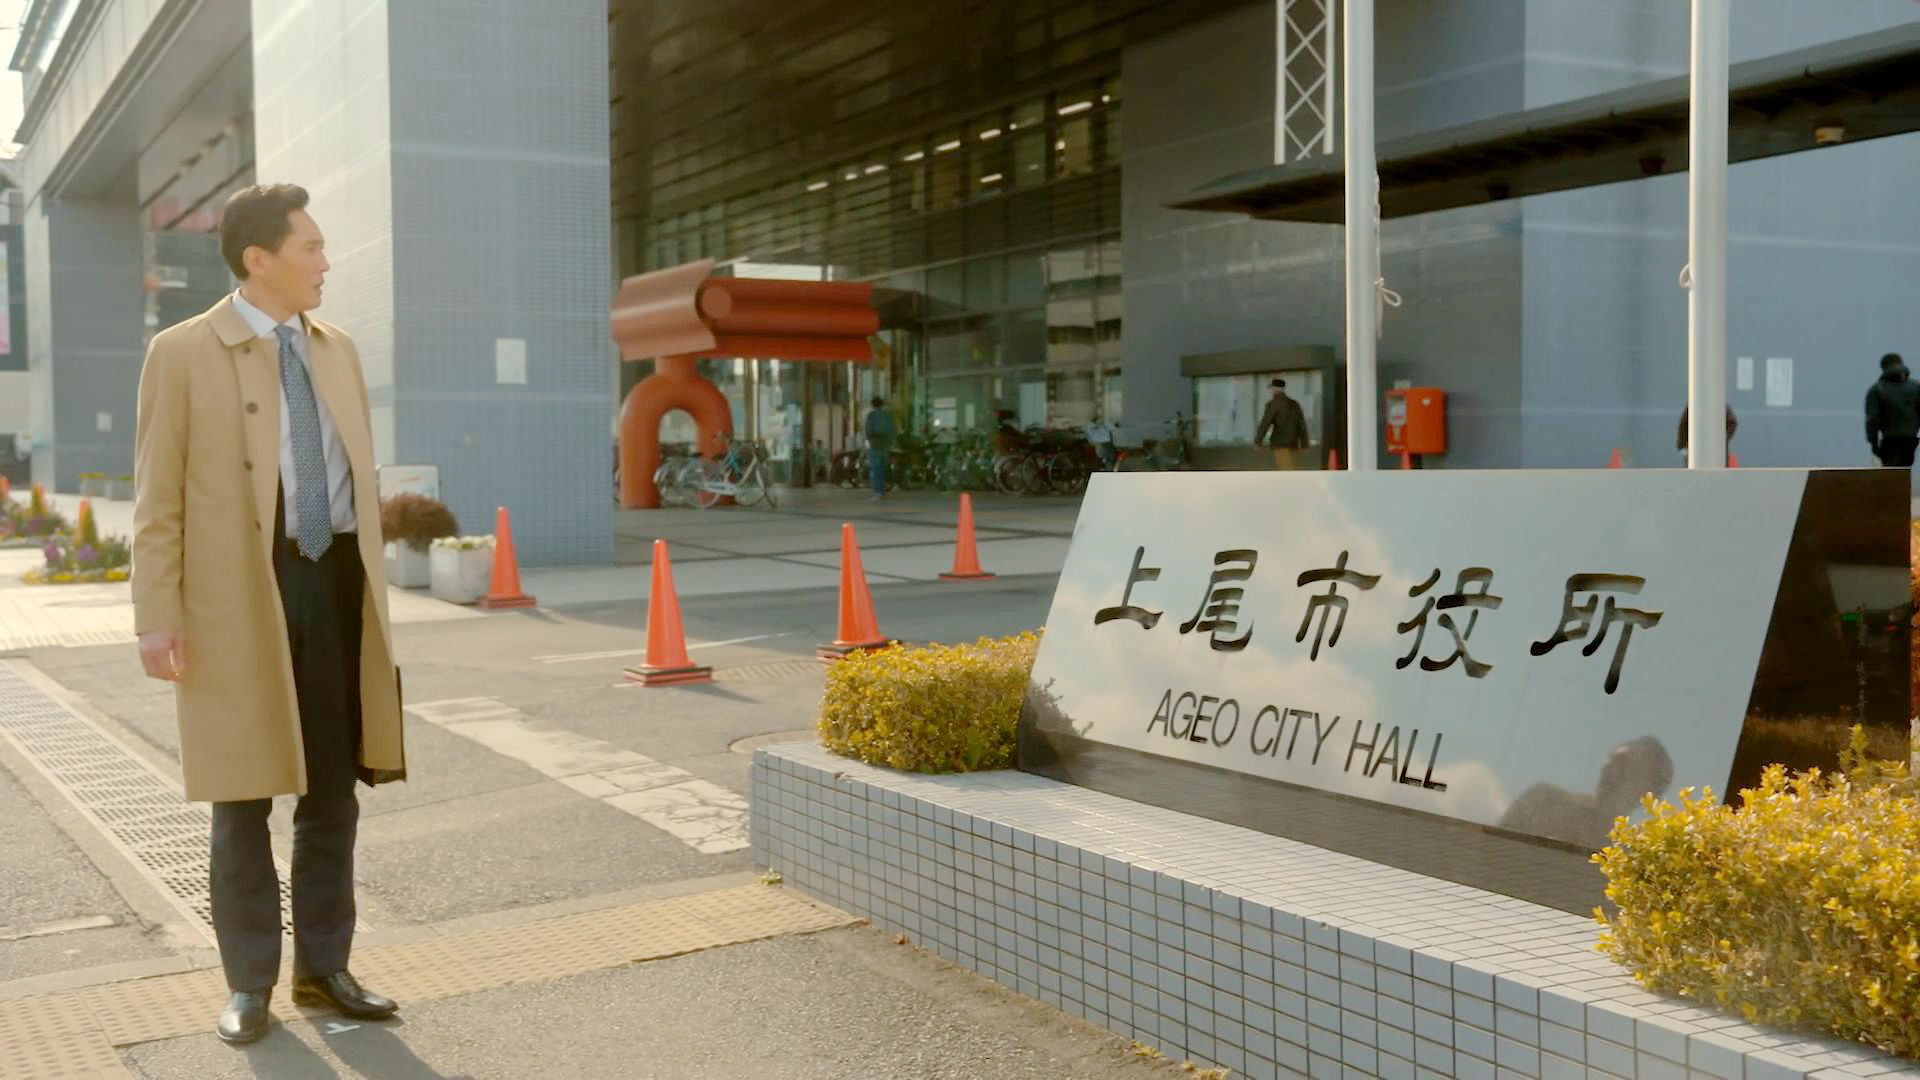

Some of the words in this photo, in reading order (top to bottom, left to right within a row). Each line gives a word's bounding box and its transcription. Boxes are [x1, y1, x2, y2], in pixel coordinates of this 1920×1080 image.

[1094, 545, 1664, 695] 上尾市役所
[1146, 688, 1240, 748] AGEO
[1249, 704, 1341, 766] CITY
[1344, 719, 1448, 793] HALL
